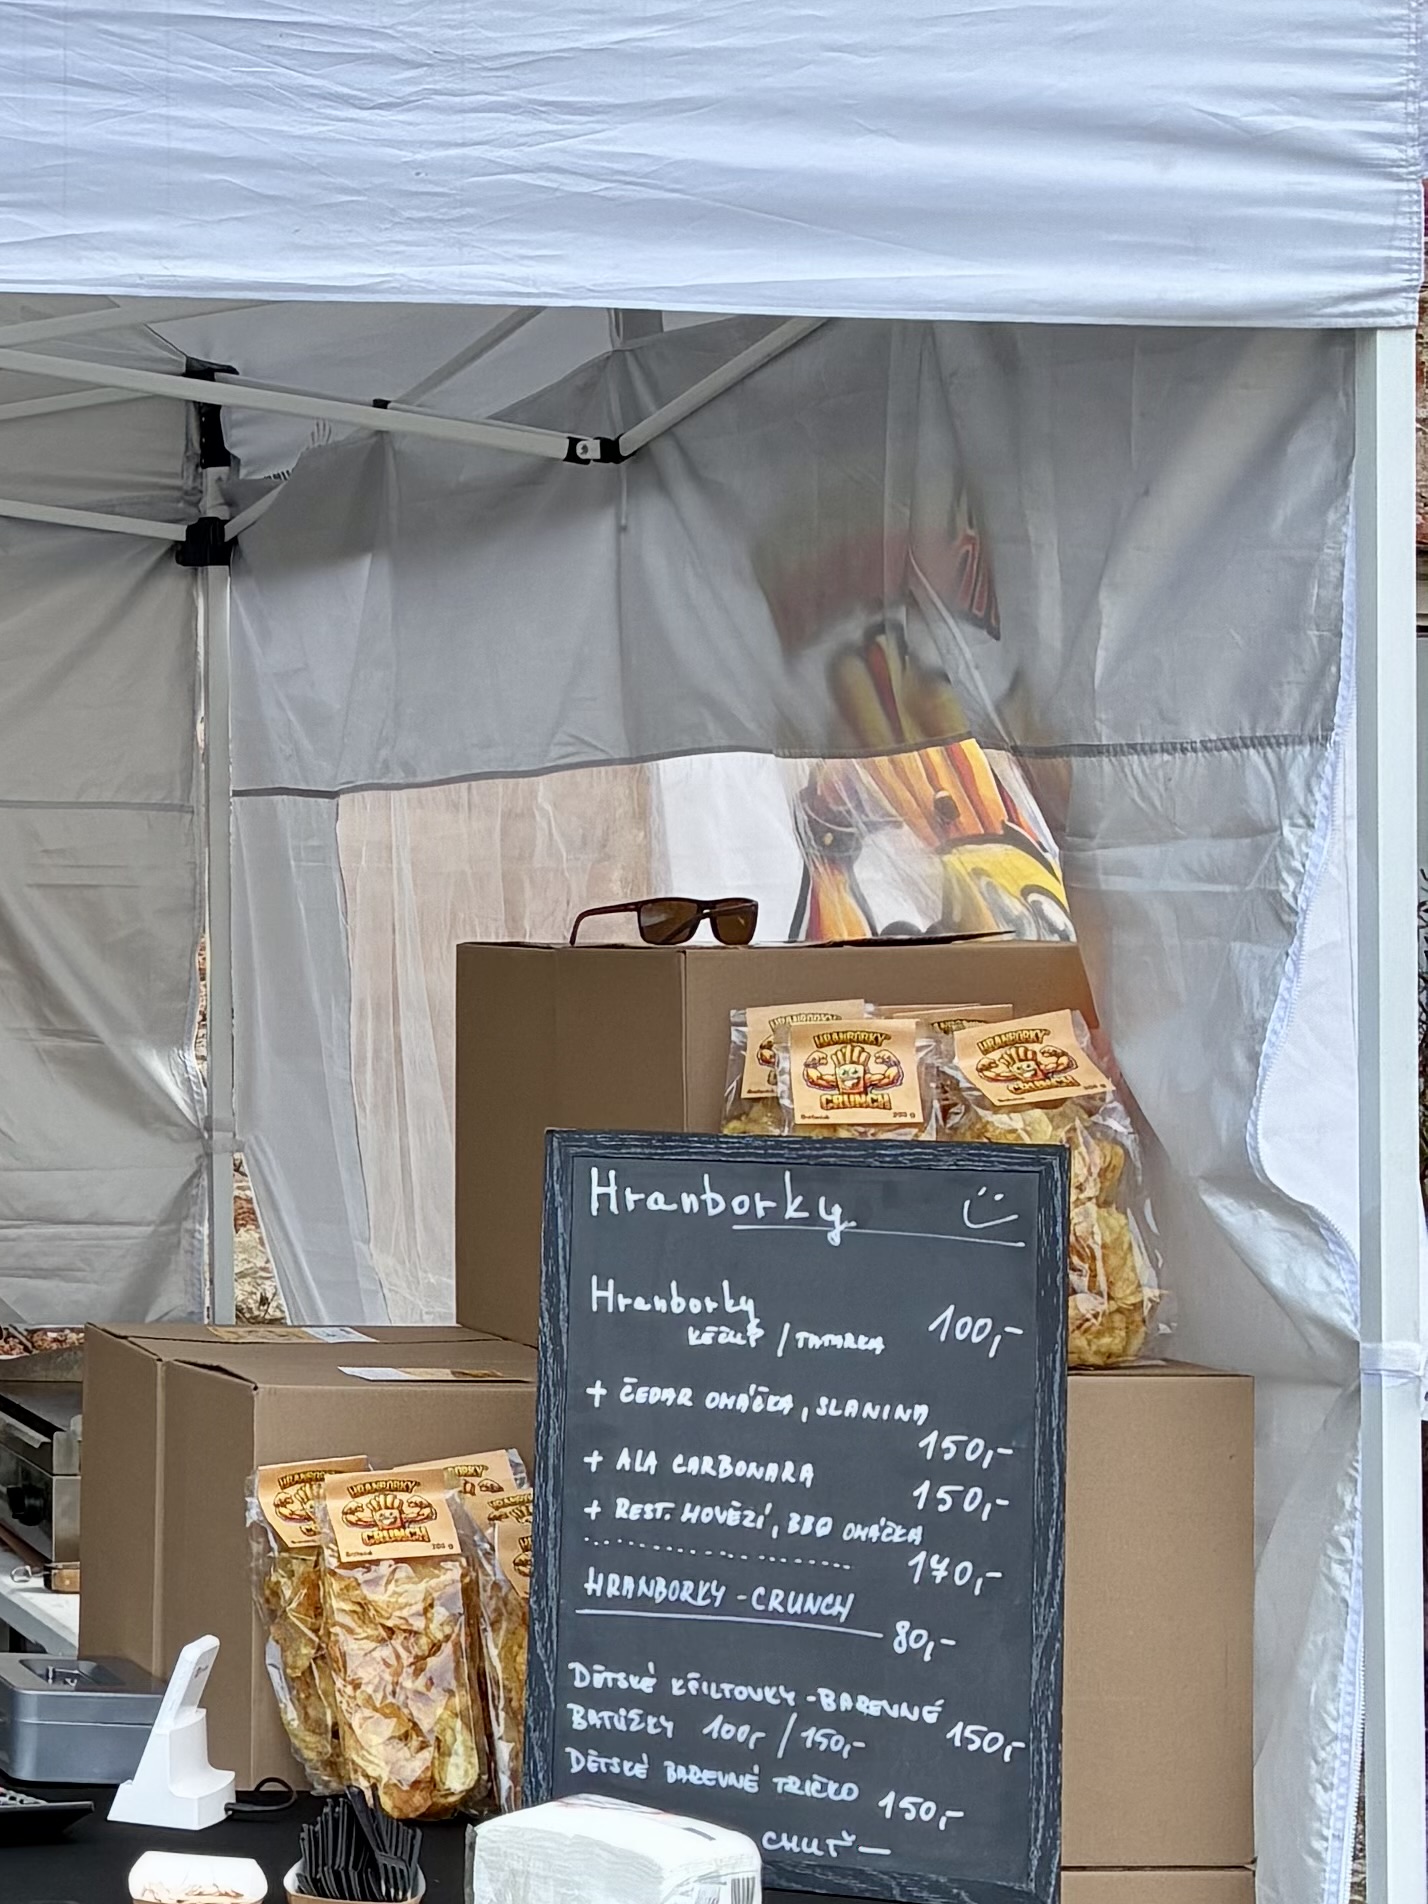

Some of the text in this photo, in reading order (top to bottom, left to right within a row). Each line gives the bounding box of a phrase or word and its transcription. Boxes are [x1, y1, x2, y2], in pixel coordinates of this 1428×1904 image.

[820, 1093, 892, 1110] CRUNCH
[590, 1167, 856, 1246] Hranborky
[591, 1275, 756, 1327] Hranborky
[619, 1377, 694, 1406] ČEDAR
[615, 1447, 657, 1475] ALA
[672, 1453, 815, 1488] CARBONARA
[918, 1429, 1014, 1470] 150,-
[912, 1479, 1010, 1522] 150,-
[361, 1526, 431, 1547] CRUNCH
[584, 1566, 727, 1608] HRANBORKY
[663, 1760, 761, 1794] BAREVNÉ
[771, 1773, 861, 1802] TRIČKO
